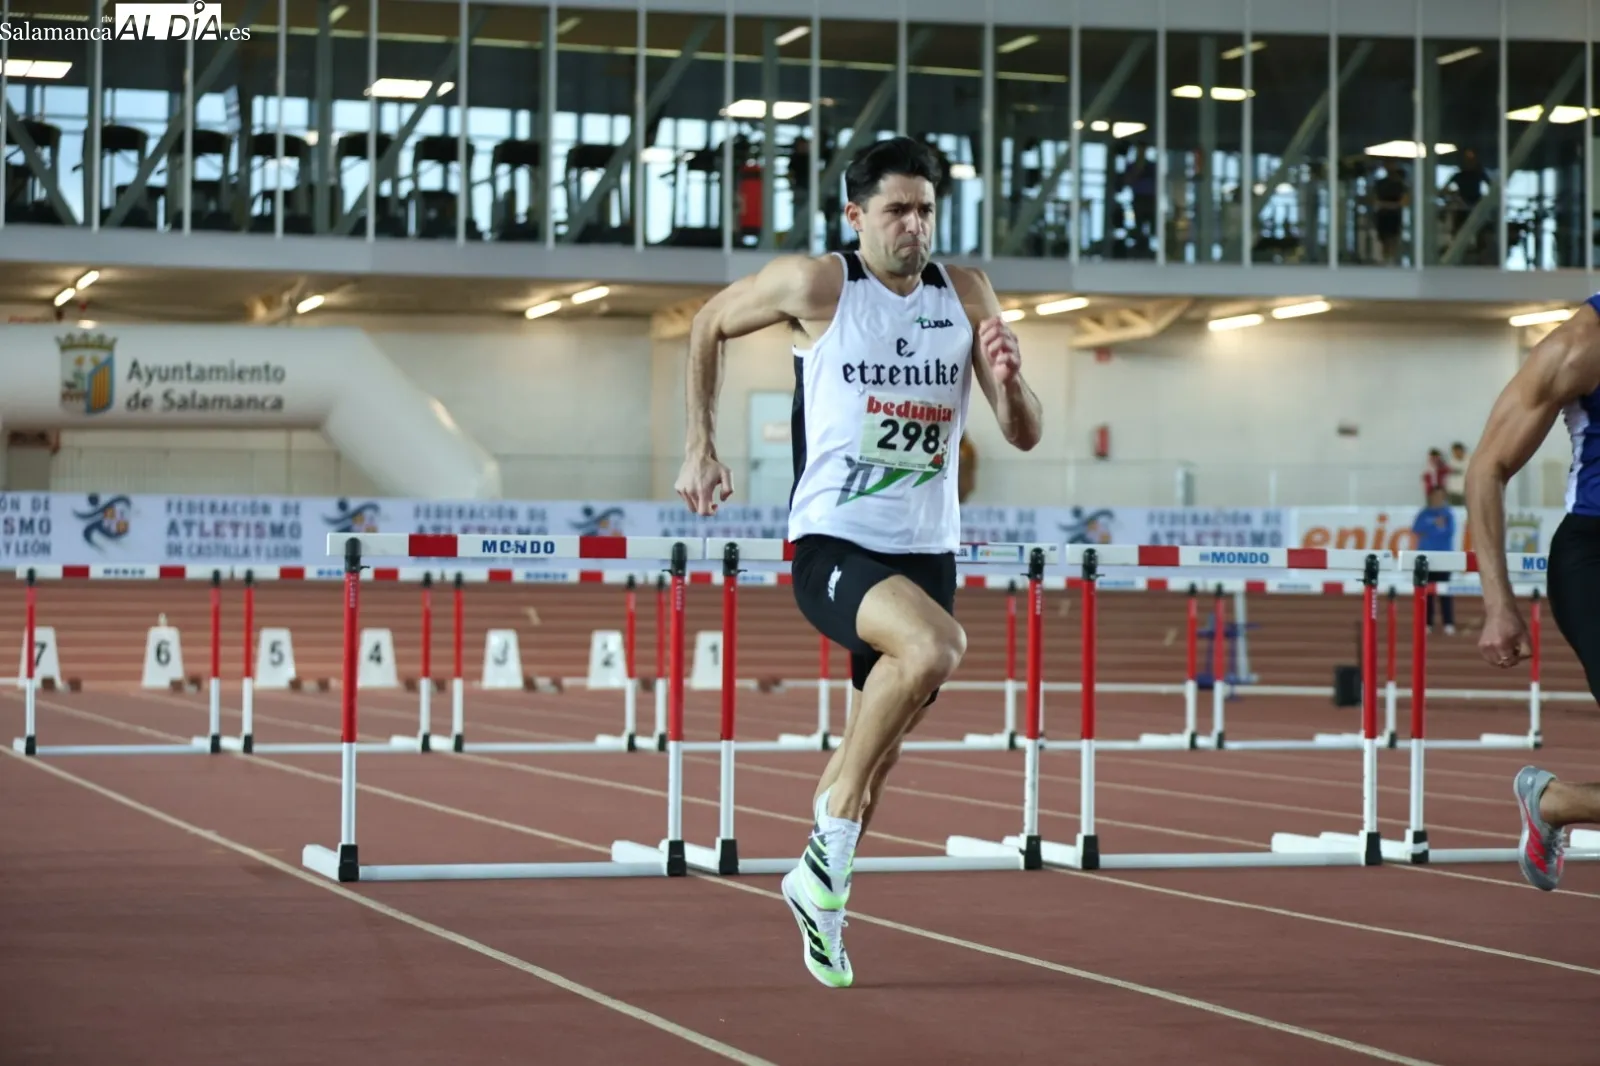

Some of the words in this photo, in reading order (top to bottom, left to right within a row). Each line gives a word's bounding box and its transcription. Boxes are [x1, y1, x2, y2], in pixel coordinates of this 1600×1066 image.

[127, 358, 286, 387] Ayuntamiento
[126, 389, 152, 411] de
[161, 388, 284, 412] Salamanca
[877, 418, 940, 454] 298
[166, 519, 302, 538] ATLETISMO
[482, 540, 555, 554] MONDO
[1211, 551, 1269, 564] MONDO
[34, 642, 46, 666] 7
[156, 640, 171, 666] 6
[270, 640, 283, 666] 5
[369, 641, 382, 665] 4
[708, 641, 719, 666] 1
